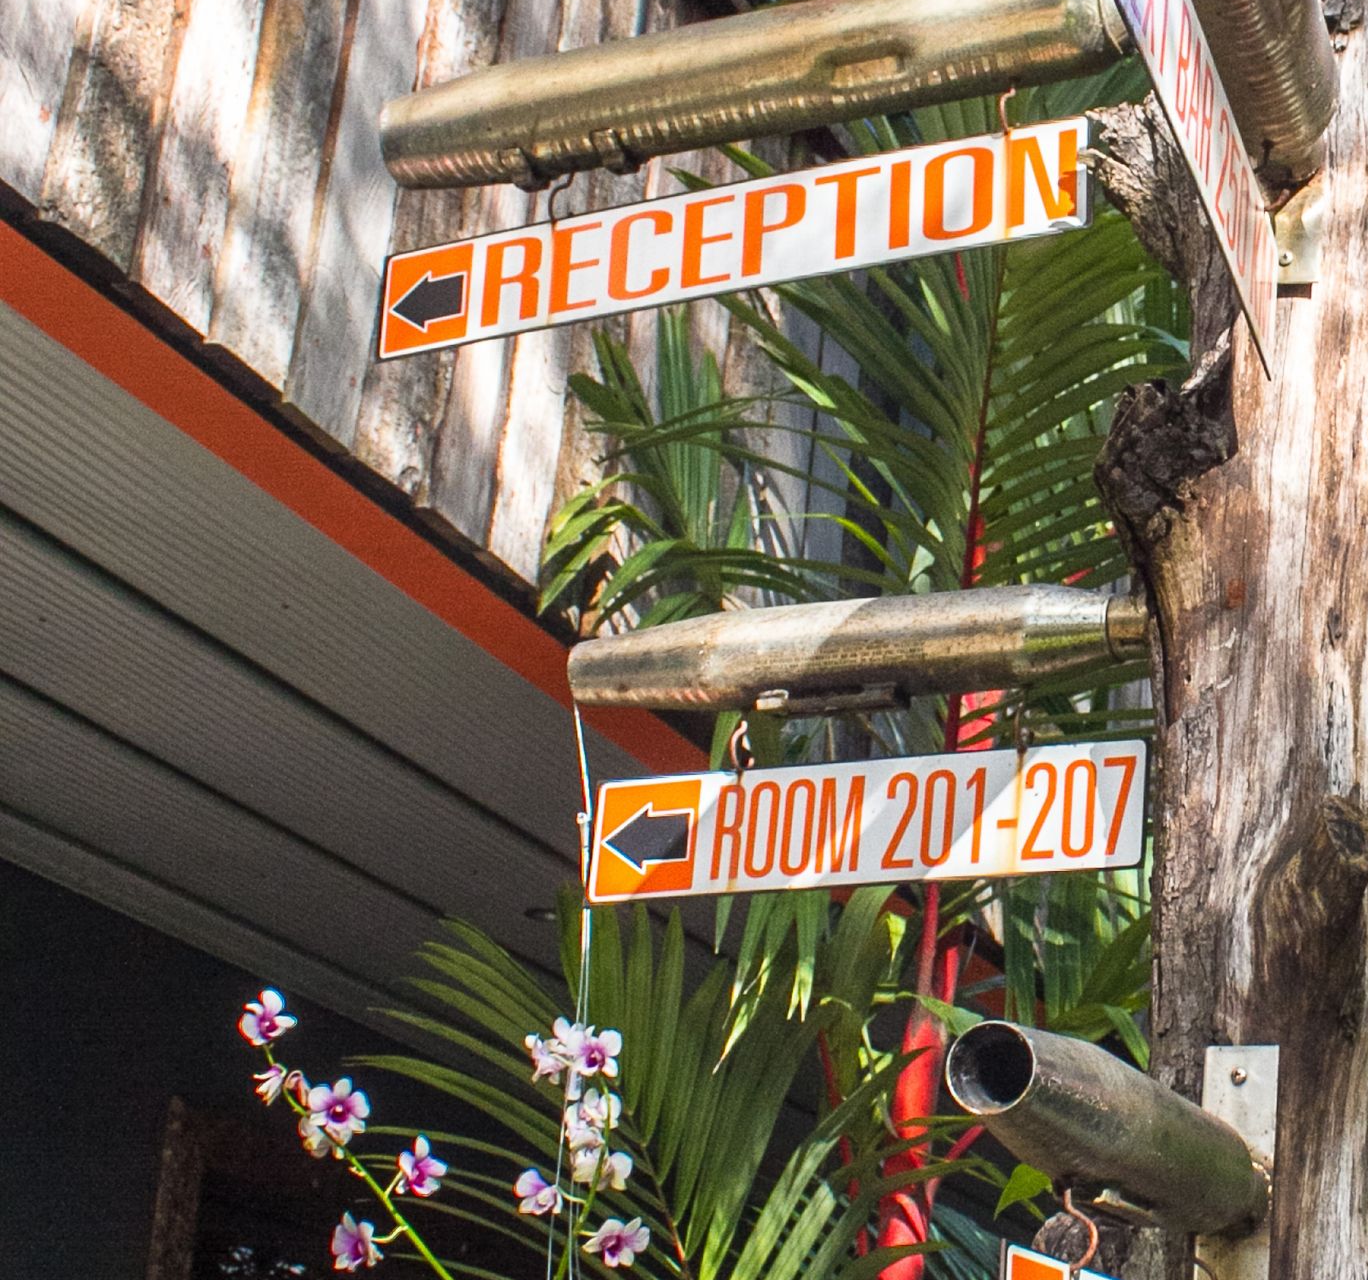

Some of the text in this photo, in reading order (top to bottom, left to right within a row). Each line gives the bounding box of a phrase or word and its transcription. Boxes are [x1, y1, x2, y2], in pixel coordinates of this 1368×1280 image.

[480, 128, 1081, 328] RECEPTION
[1176, 0, 1214, 187] BAR
[1215, 107, 1250, 278] 250
[710, 755, 1137, 881] ROOM 201-207
